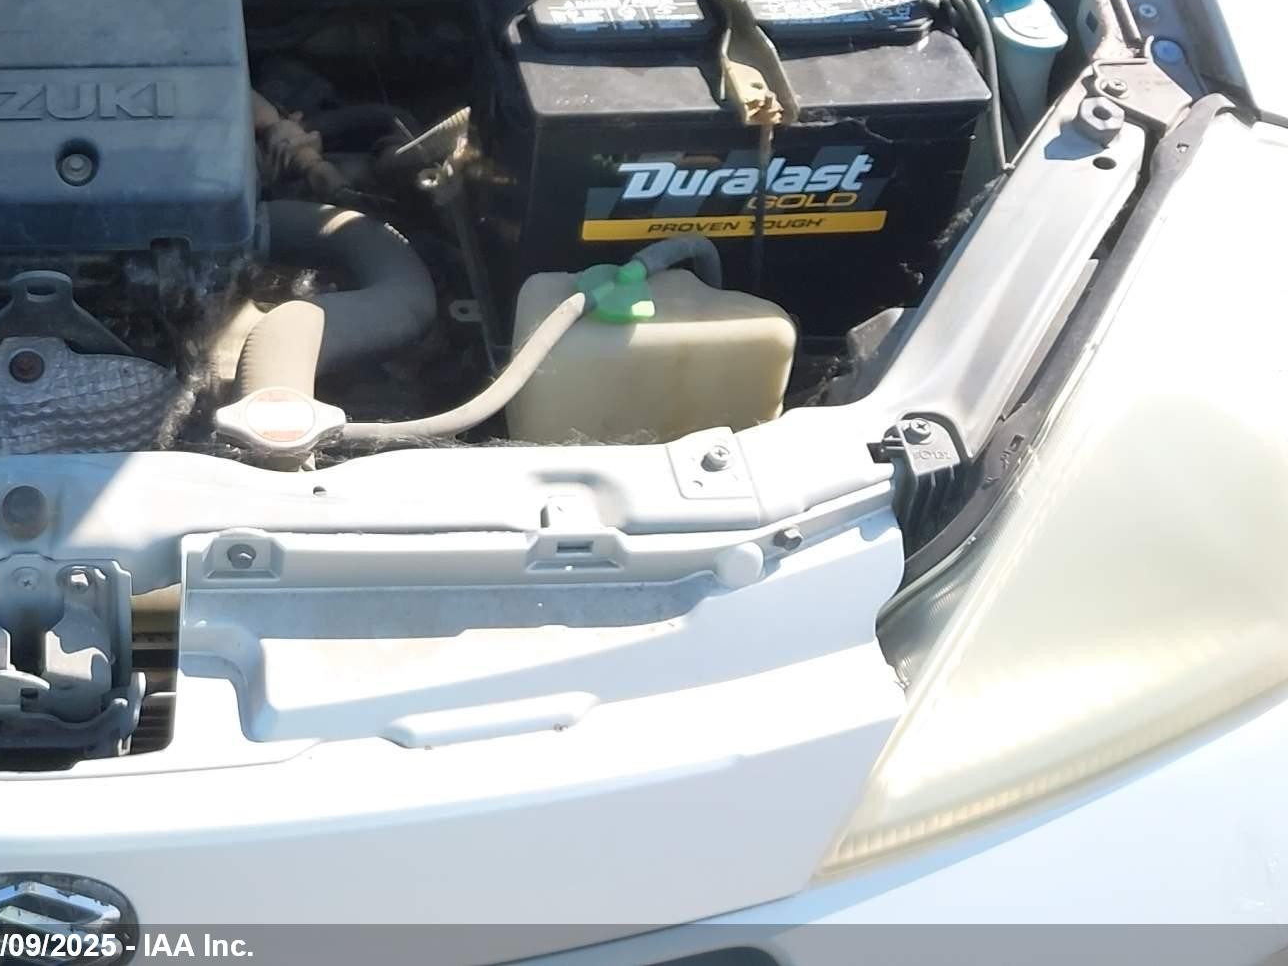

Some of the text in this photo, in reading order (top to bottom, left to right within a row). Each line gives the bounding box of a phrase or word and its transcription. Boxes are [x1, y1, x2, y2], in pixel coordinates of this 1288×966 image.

[618, 154, 874, 199] Duralast
[746, 191, 858, 210] GOLD
[648, 220, 740, 234] PROVEN
